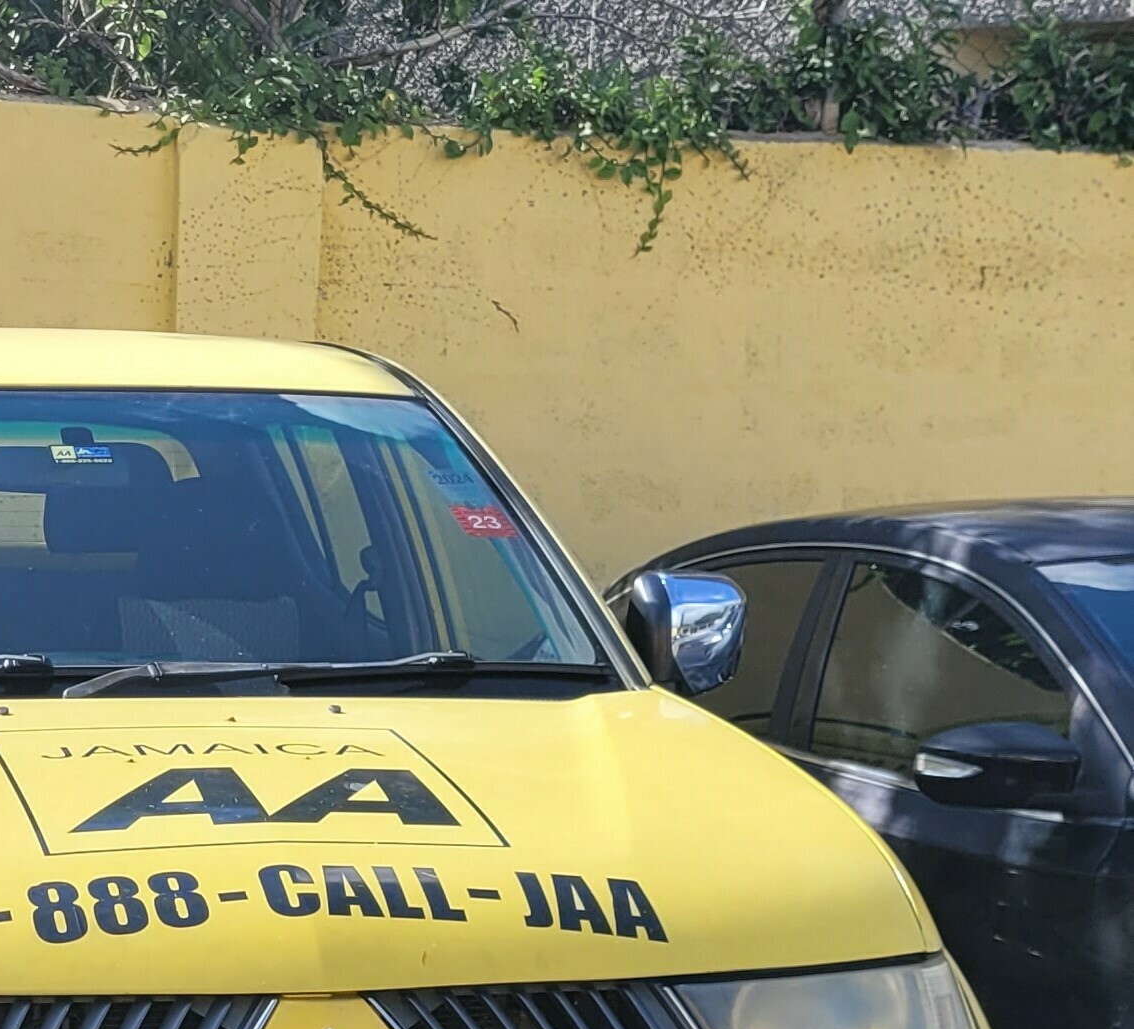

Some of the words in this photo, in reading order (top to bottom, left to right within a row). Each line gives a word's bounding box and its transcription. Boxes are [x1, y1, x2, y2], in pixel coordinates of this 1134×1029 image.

[467, 515, 502, 530] 23
[41, 741, 386, 760] JAMAICA
[68, 766, 462, 833] AA
